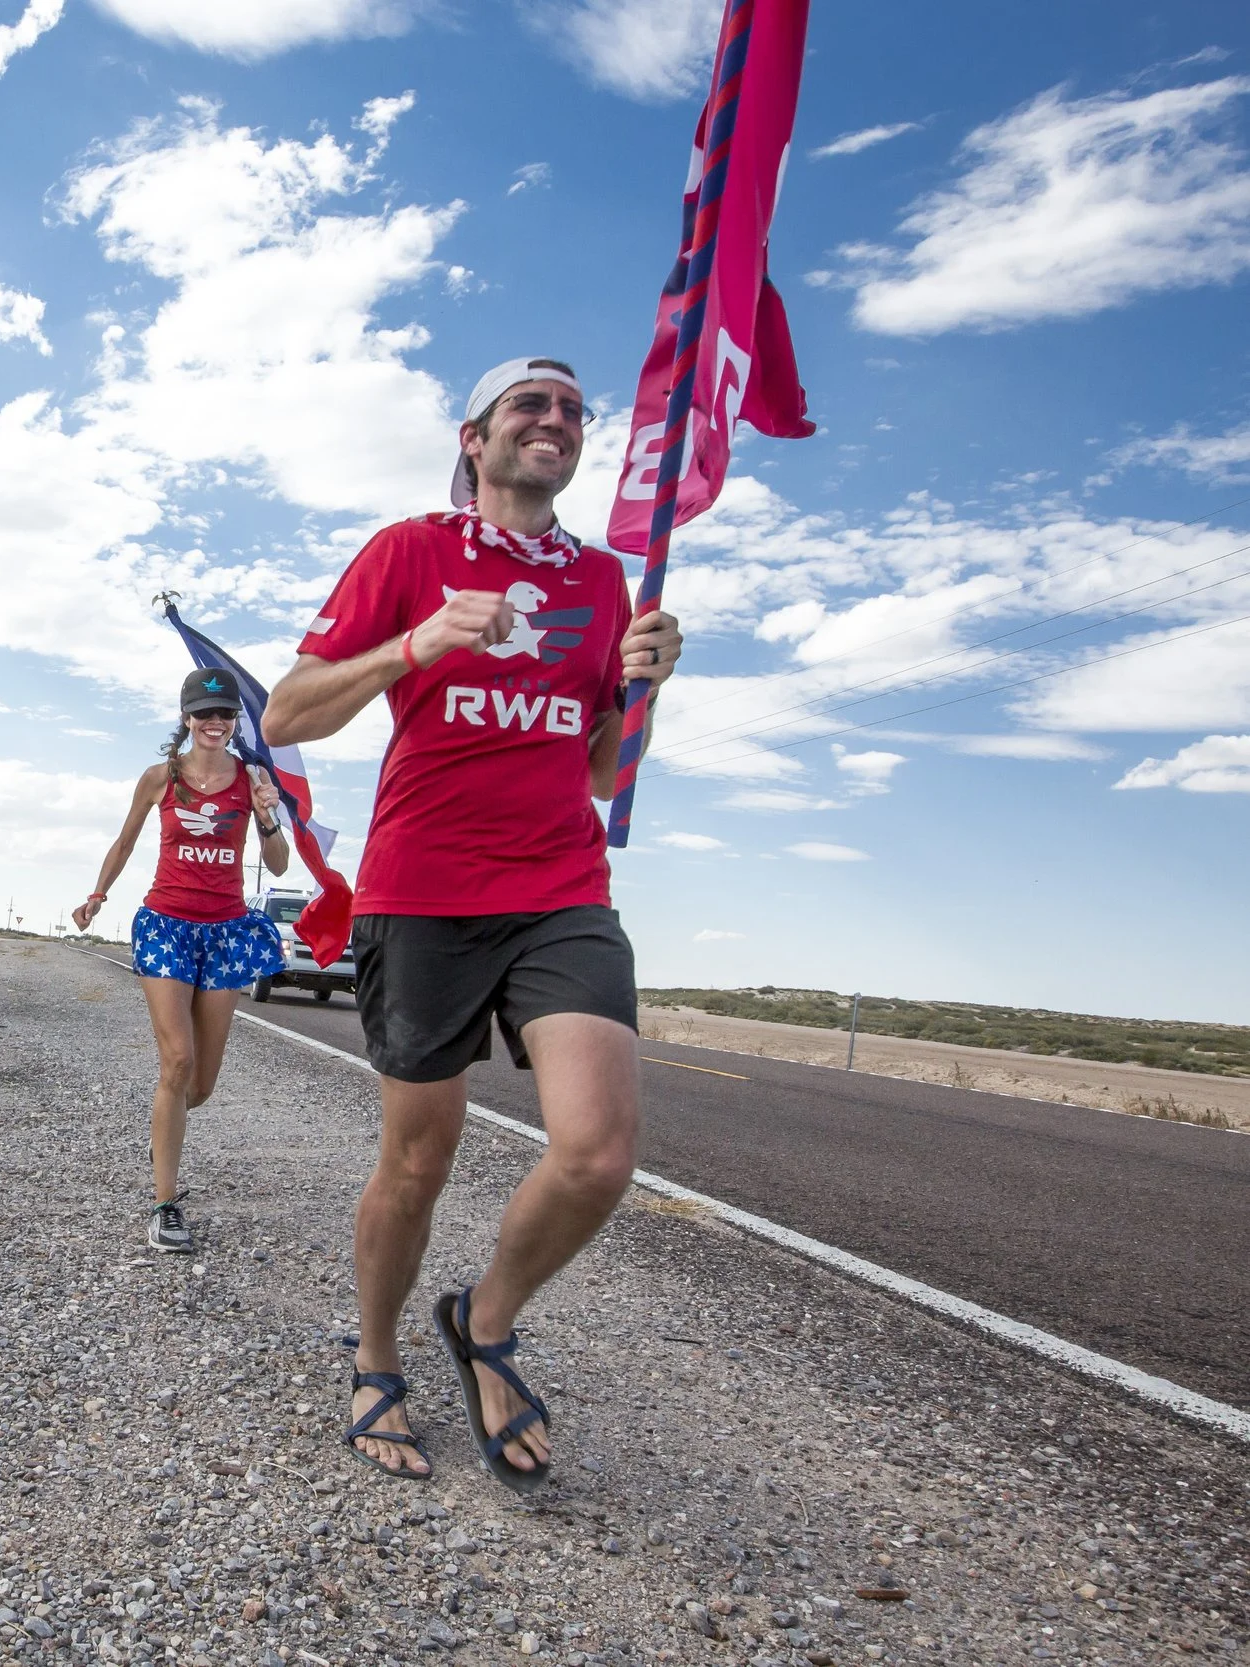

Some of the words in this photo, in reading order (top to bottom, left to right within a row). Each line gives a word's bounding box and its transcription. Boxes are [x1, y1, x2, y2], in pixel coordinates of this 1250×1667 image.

[493, 673, 550, 691] TEAM
[444, 685, 582, 736] RWB
[178, 845, 235, 864] RWB
